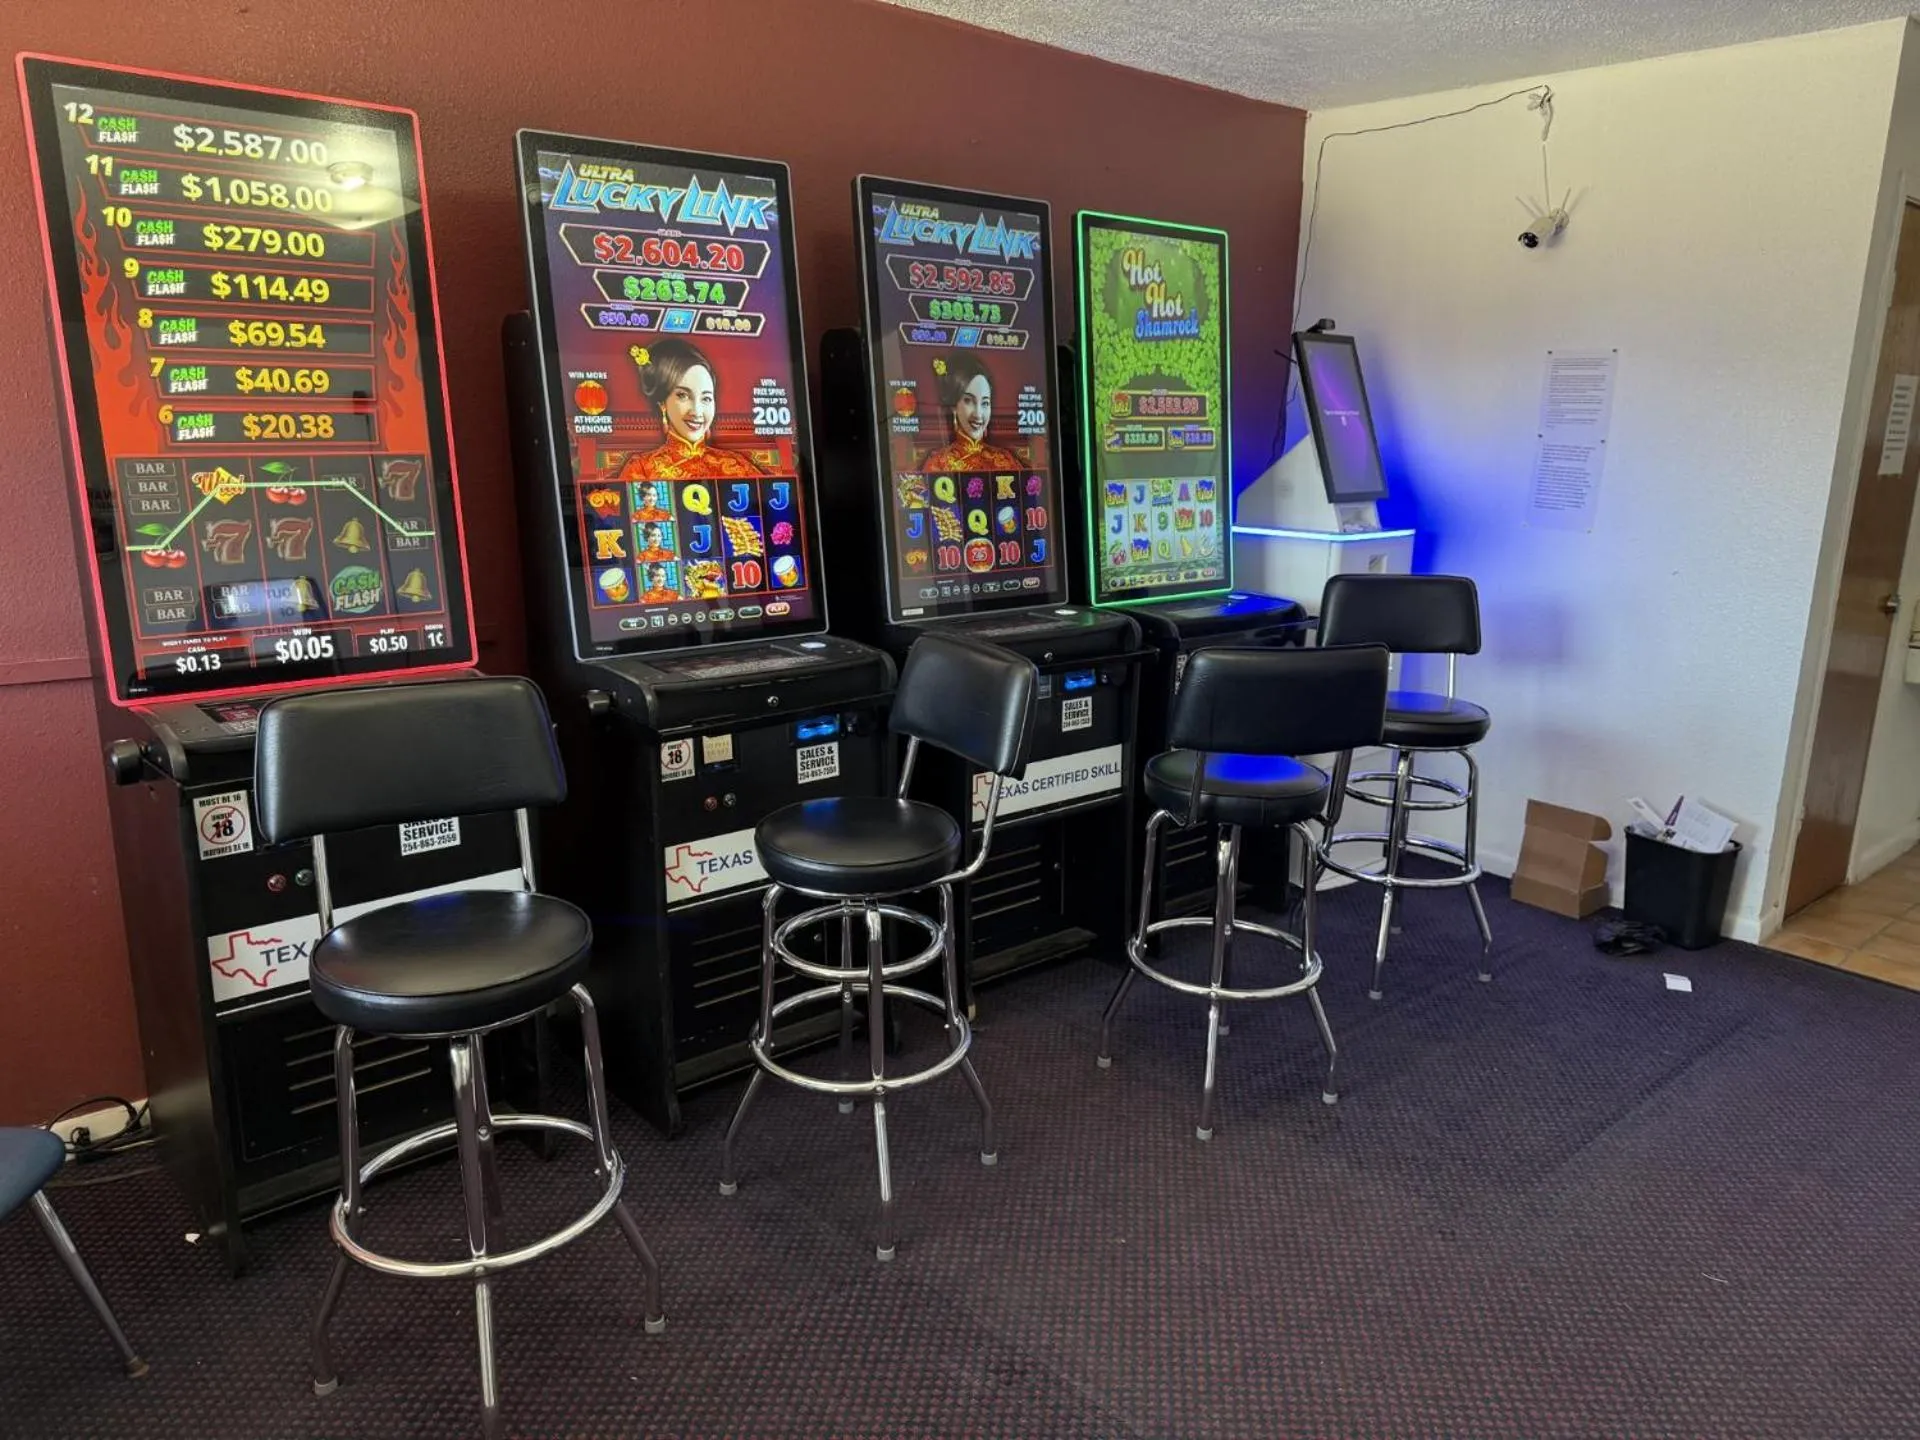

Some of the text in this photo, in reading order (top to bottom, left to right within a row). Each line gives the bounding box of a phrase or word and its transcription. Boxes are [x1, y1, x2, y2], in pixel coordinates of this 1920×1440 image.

[63, 102, 93, 125] 12
[173, 123, 328, 165] $2,587.00
[85, 154, 114, 177] 11
[579, 164, 635, 182] ULTRA
[181, 173, 333, 213] $1,058.00
[102, 206, 132, 227] 10
[900, 202, 939, 219] ULTRA
[203, 223, 325, 257] $279.00
[124, 257, 139, 278] 9
[1122, 247, 1163, 286] Hot
[210, 271, 330, 304] $114.49
[1145, 282, 1184, 318] Hot
[138, 308, 153, 328] 8
[1135, 309, 1200, 338] Shamrock
[228, 320, 325, 348] $69.54
[150, 357, 165, 377] 7
[236, 366, 330, 394] $40.69
[159, 405, 173, 424] 6
[752, 407, 791, 425] 200
[1018, 410, 1045, 425] 200
[243, 413, 335, 440] $20.38
[576, 425, 612, 433] DENOMS
[136, 463, 165, 473] BAR
[138, 481, 168, 492] BAR
[728, 484, 749, 512] J
[769, 482, 790, 510] J
[934, 476, 956, 503] Q
[996, 476, 1016, 500] K
[141, 500, 171, 511] BAR
[682, 484, 712, 515] Q
[906, 512, 923, 538] J
[968, 509, 988, 535] Q
[1026, 506, 1047, 530] 10
[396, 537, 420, 547] BAR
[594, 529, 626, 559] K
[690, 525, 711, 553] J
[938, 545, 961, 569] 10
[999, 541, 1020, 565] 10
[732, 561, 762, 589] 10
[154, 590, 184, 602] BAR
[221, 585, 249, 596] BAR
[157, 608, 187, 620] BAR
[275, 636, 334, 663] $0.05
[370, 636, 408, 653] $0.50
[176, 654, 221, 675] $0.13
[668, 750, 682, 764] 18
[800, 746, 834, 760] SALES &
[800, 755, 835, 771] SERVICE
[998, 762, 1120, 799] EXAS CERTIFIED SKILL
[199, 797, 220, 807] MUST
[222, 795, 230, 803] BE
[212, 819, 234, 838] 18
[404, 821, 454, 841] SERVICE
[697, 850, 753, 875] TEXAS
[260, 939, 319, 966] TEX
